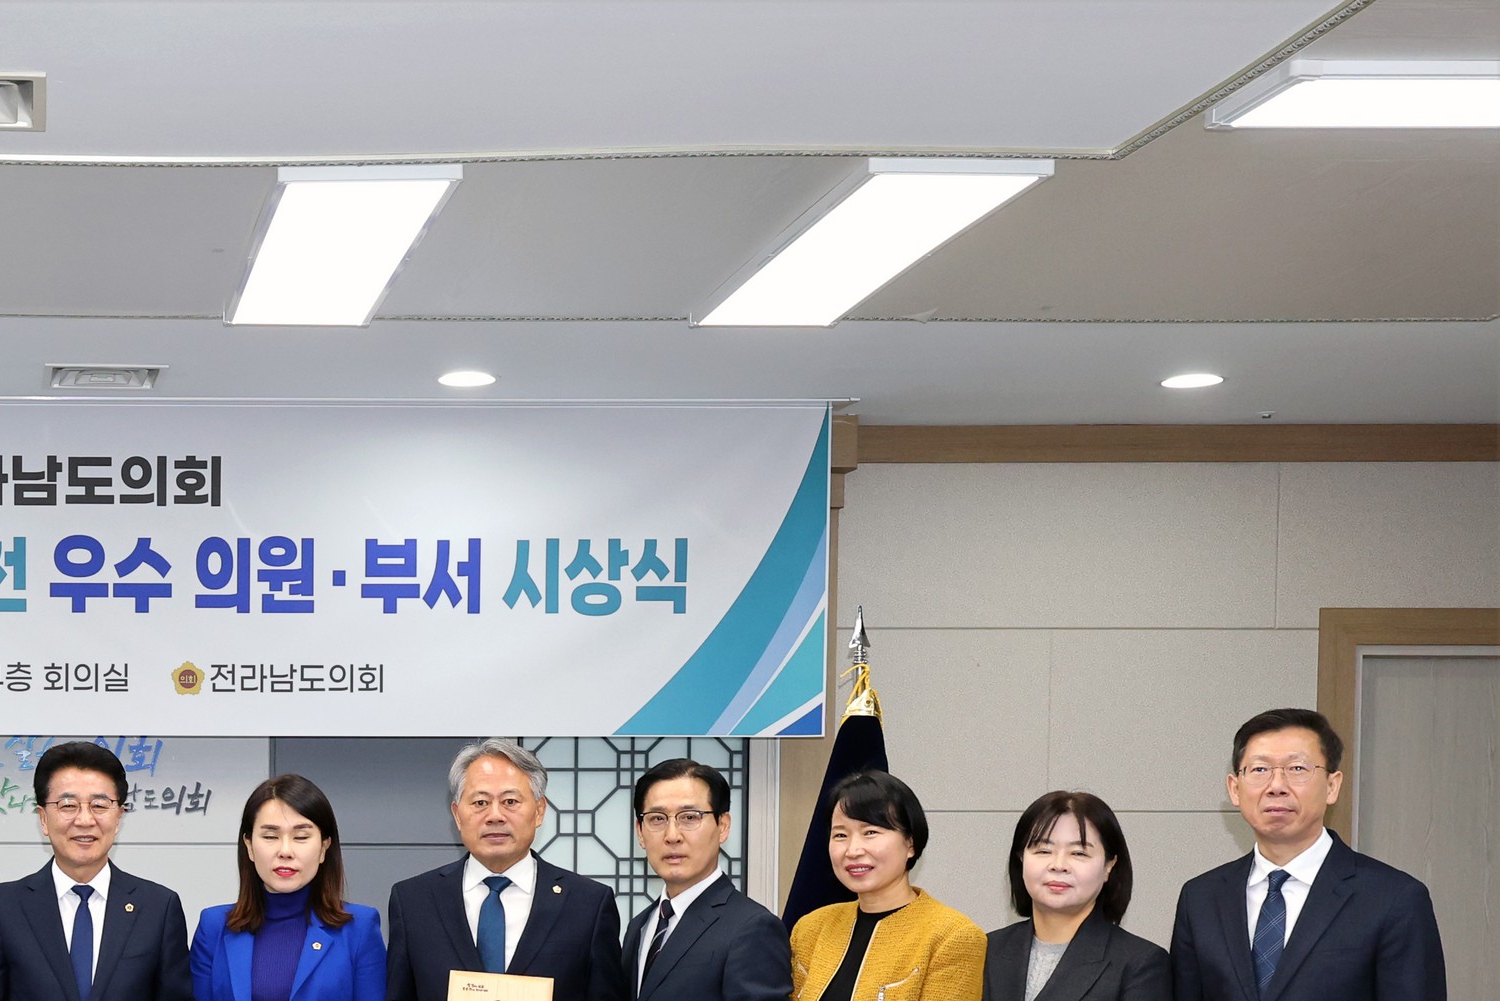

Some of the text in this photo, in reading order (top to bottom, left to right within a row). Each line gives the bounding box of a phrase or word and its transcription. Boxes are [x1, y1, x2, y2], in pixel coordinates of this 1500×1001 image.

[49, 534, 173, 614] 우수
[502, 537, 688, 617] 시상식
[43, 662, 129, 693] 회의실
[210, 663, 384, 694] 전라남도의회
